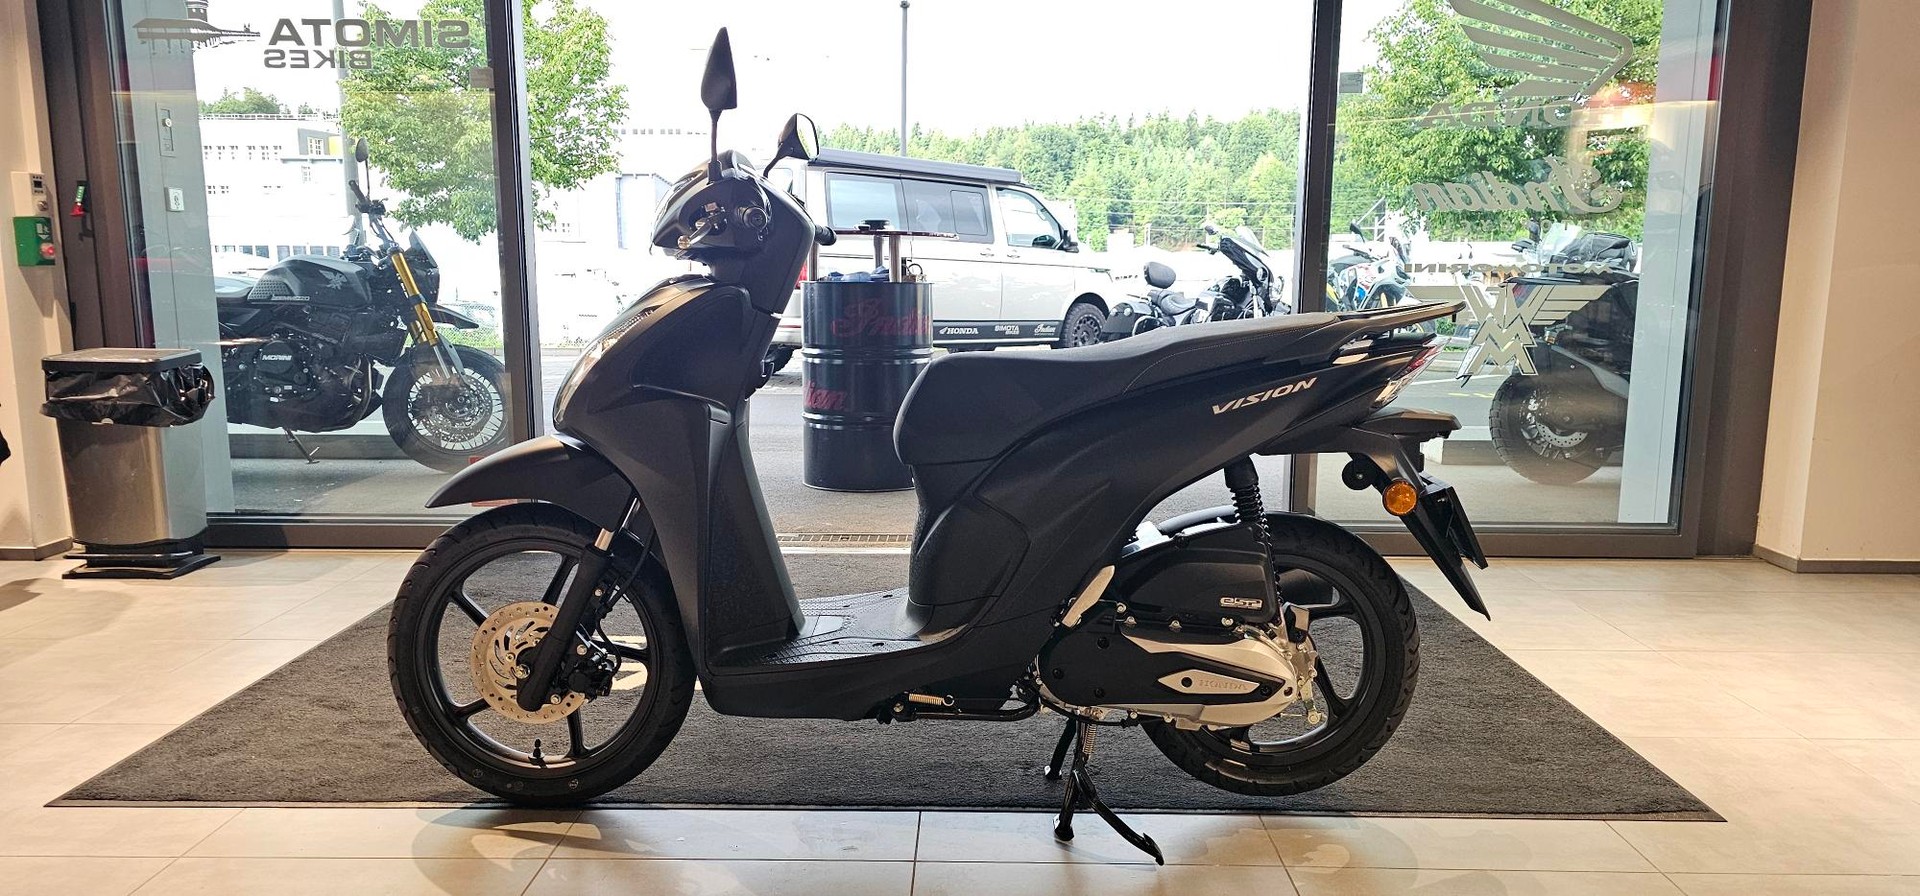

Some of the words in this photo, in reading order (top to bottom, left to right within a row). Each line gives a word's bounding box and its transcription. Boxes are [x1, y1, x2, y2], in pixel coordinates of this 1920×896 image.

[946, 327, 979, 335] HONDA
[1211, 377, 1318, 415] VISION
[1199, 679, 1248, 691] HONDA
